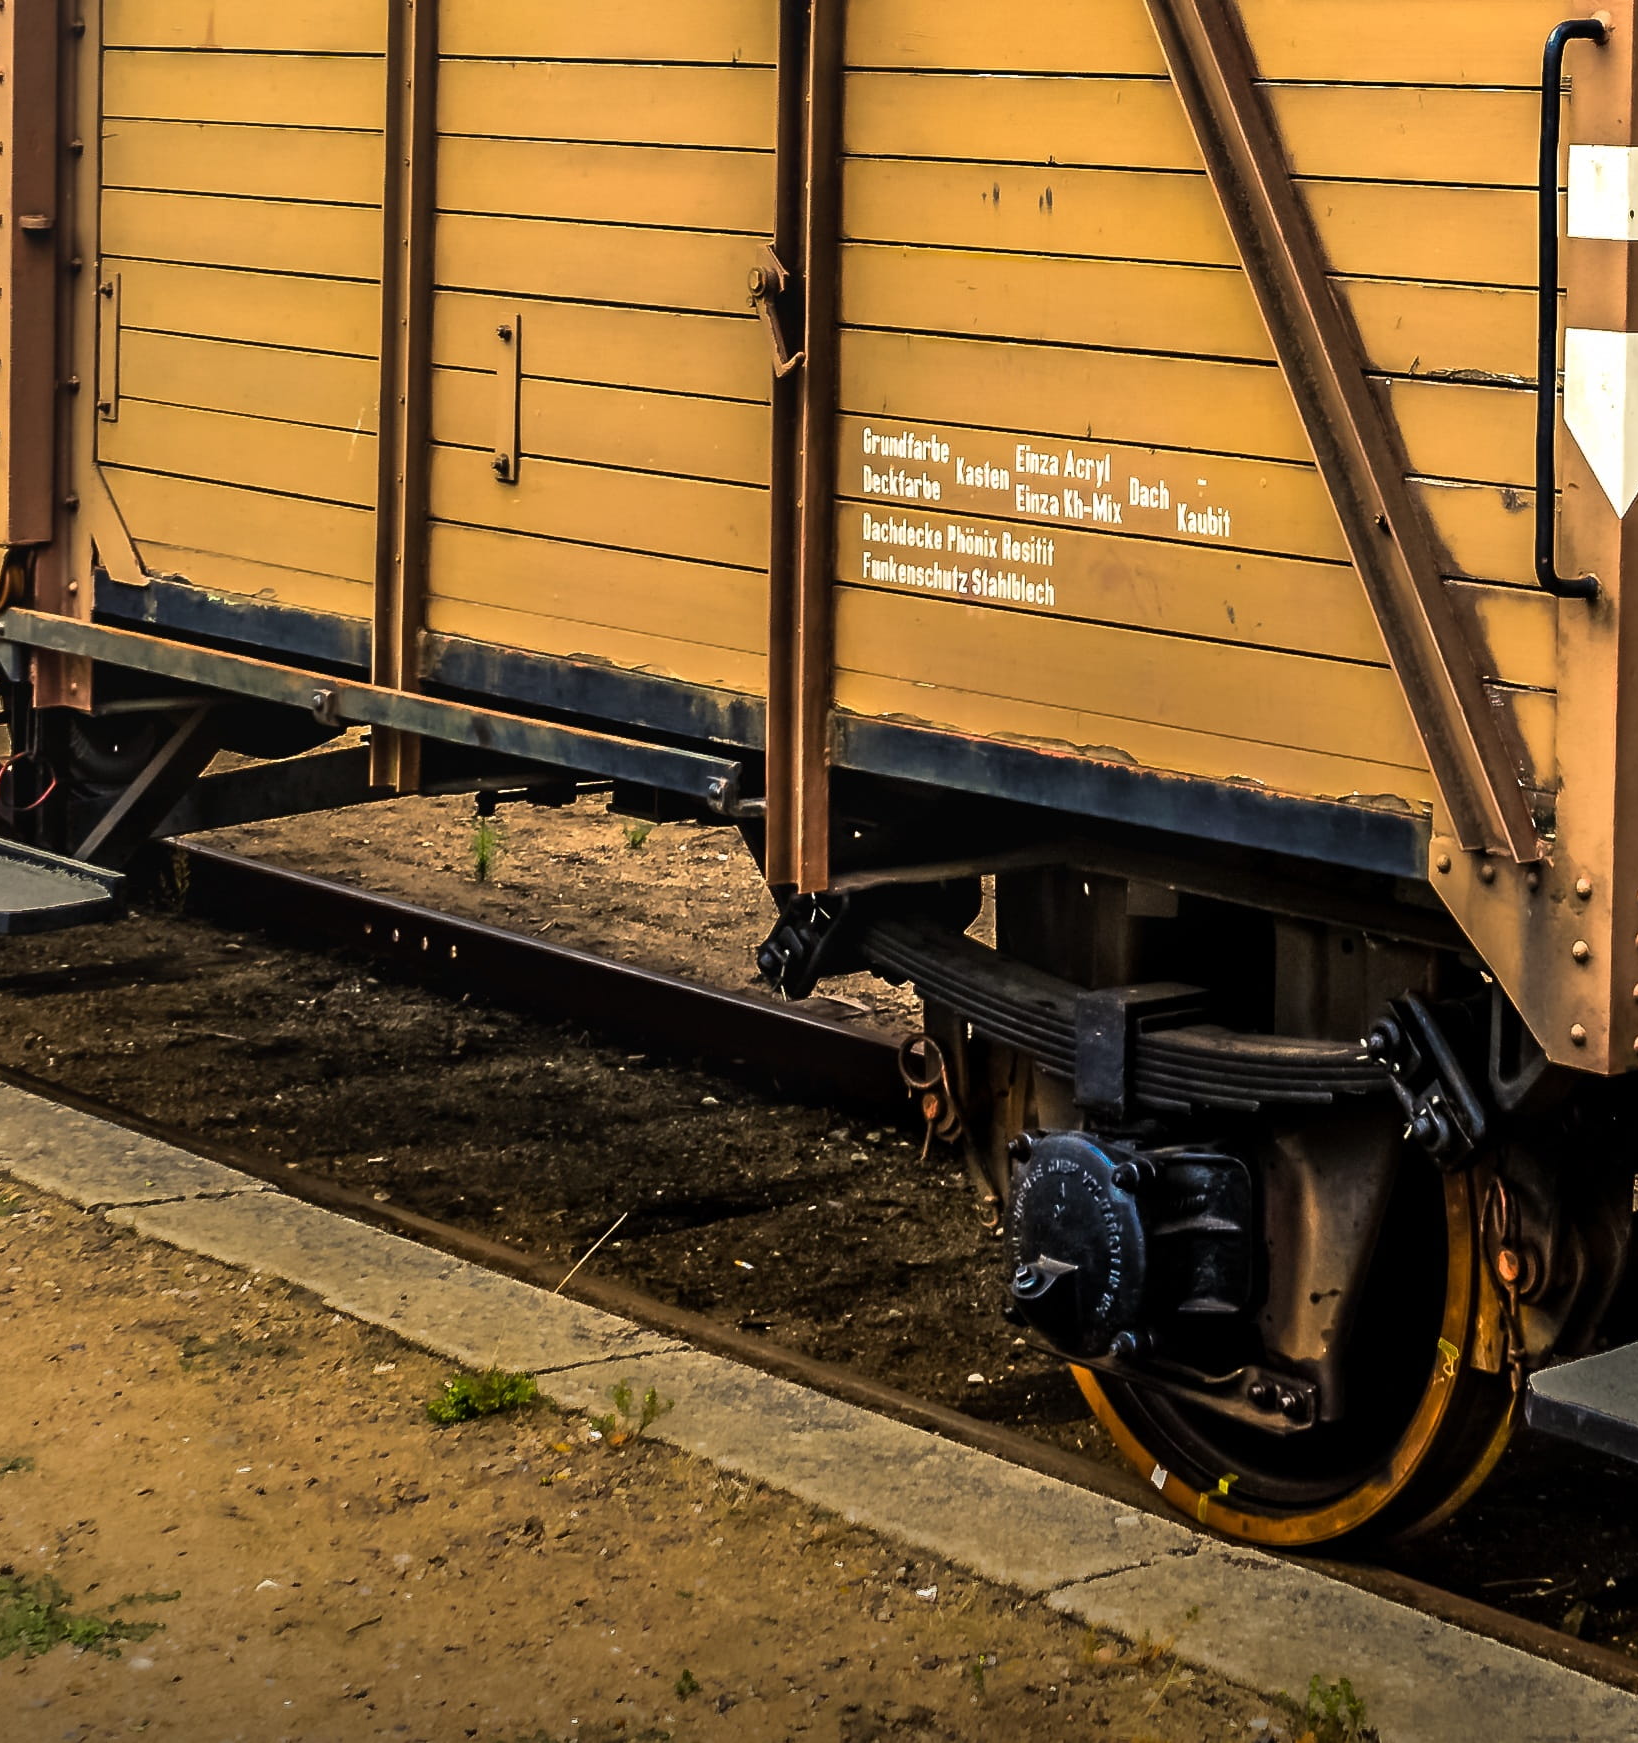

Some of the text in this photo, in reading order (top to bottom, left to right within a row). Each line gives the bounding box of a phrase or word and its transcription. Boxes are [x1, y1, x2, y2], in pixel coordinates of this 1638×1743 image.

[863, 427, 950, 464] Grundfarbe
[863, 464, 941, 501] Deckfarbe
[956, 456, 1010, 491] Kasten
[1015, 444, 1111, 488] Einza Acryl
[1015, 484, 1122, 524] Einza Kh-Mix
[1129, 476, 1170, 510] Dach
[863, 512, 943, 550] Dachdecke
[947, 524, 998, 559] Phönix
[1177, 502, 1231, 538] Kaubit
[863, 551, 1055, 606] Funkenschutz Stahlblech
